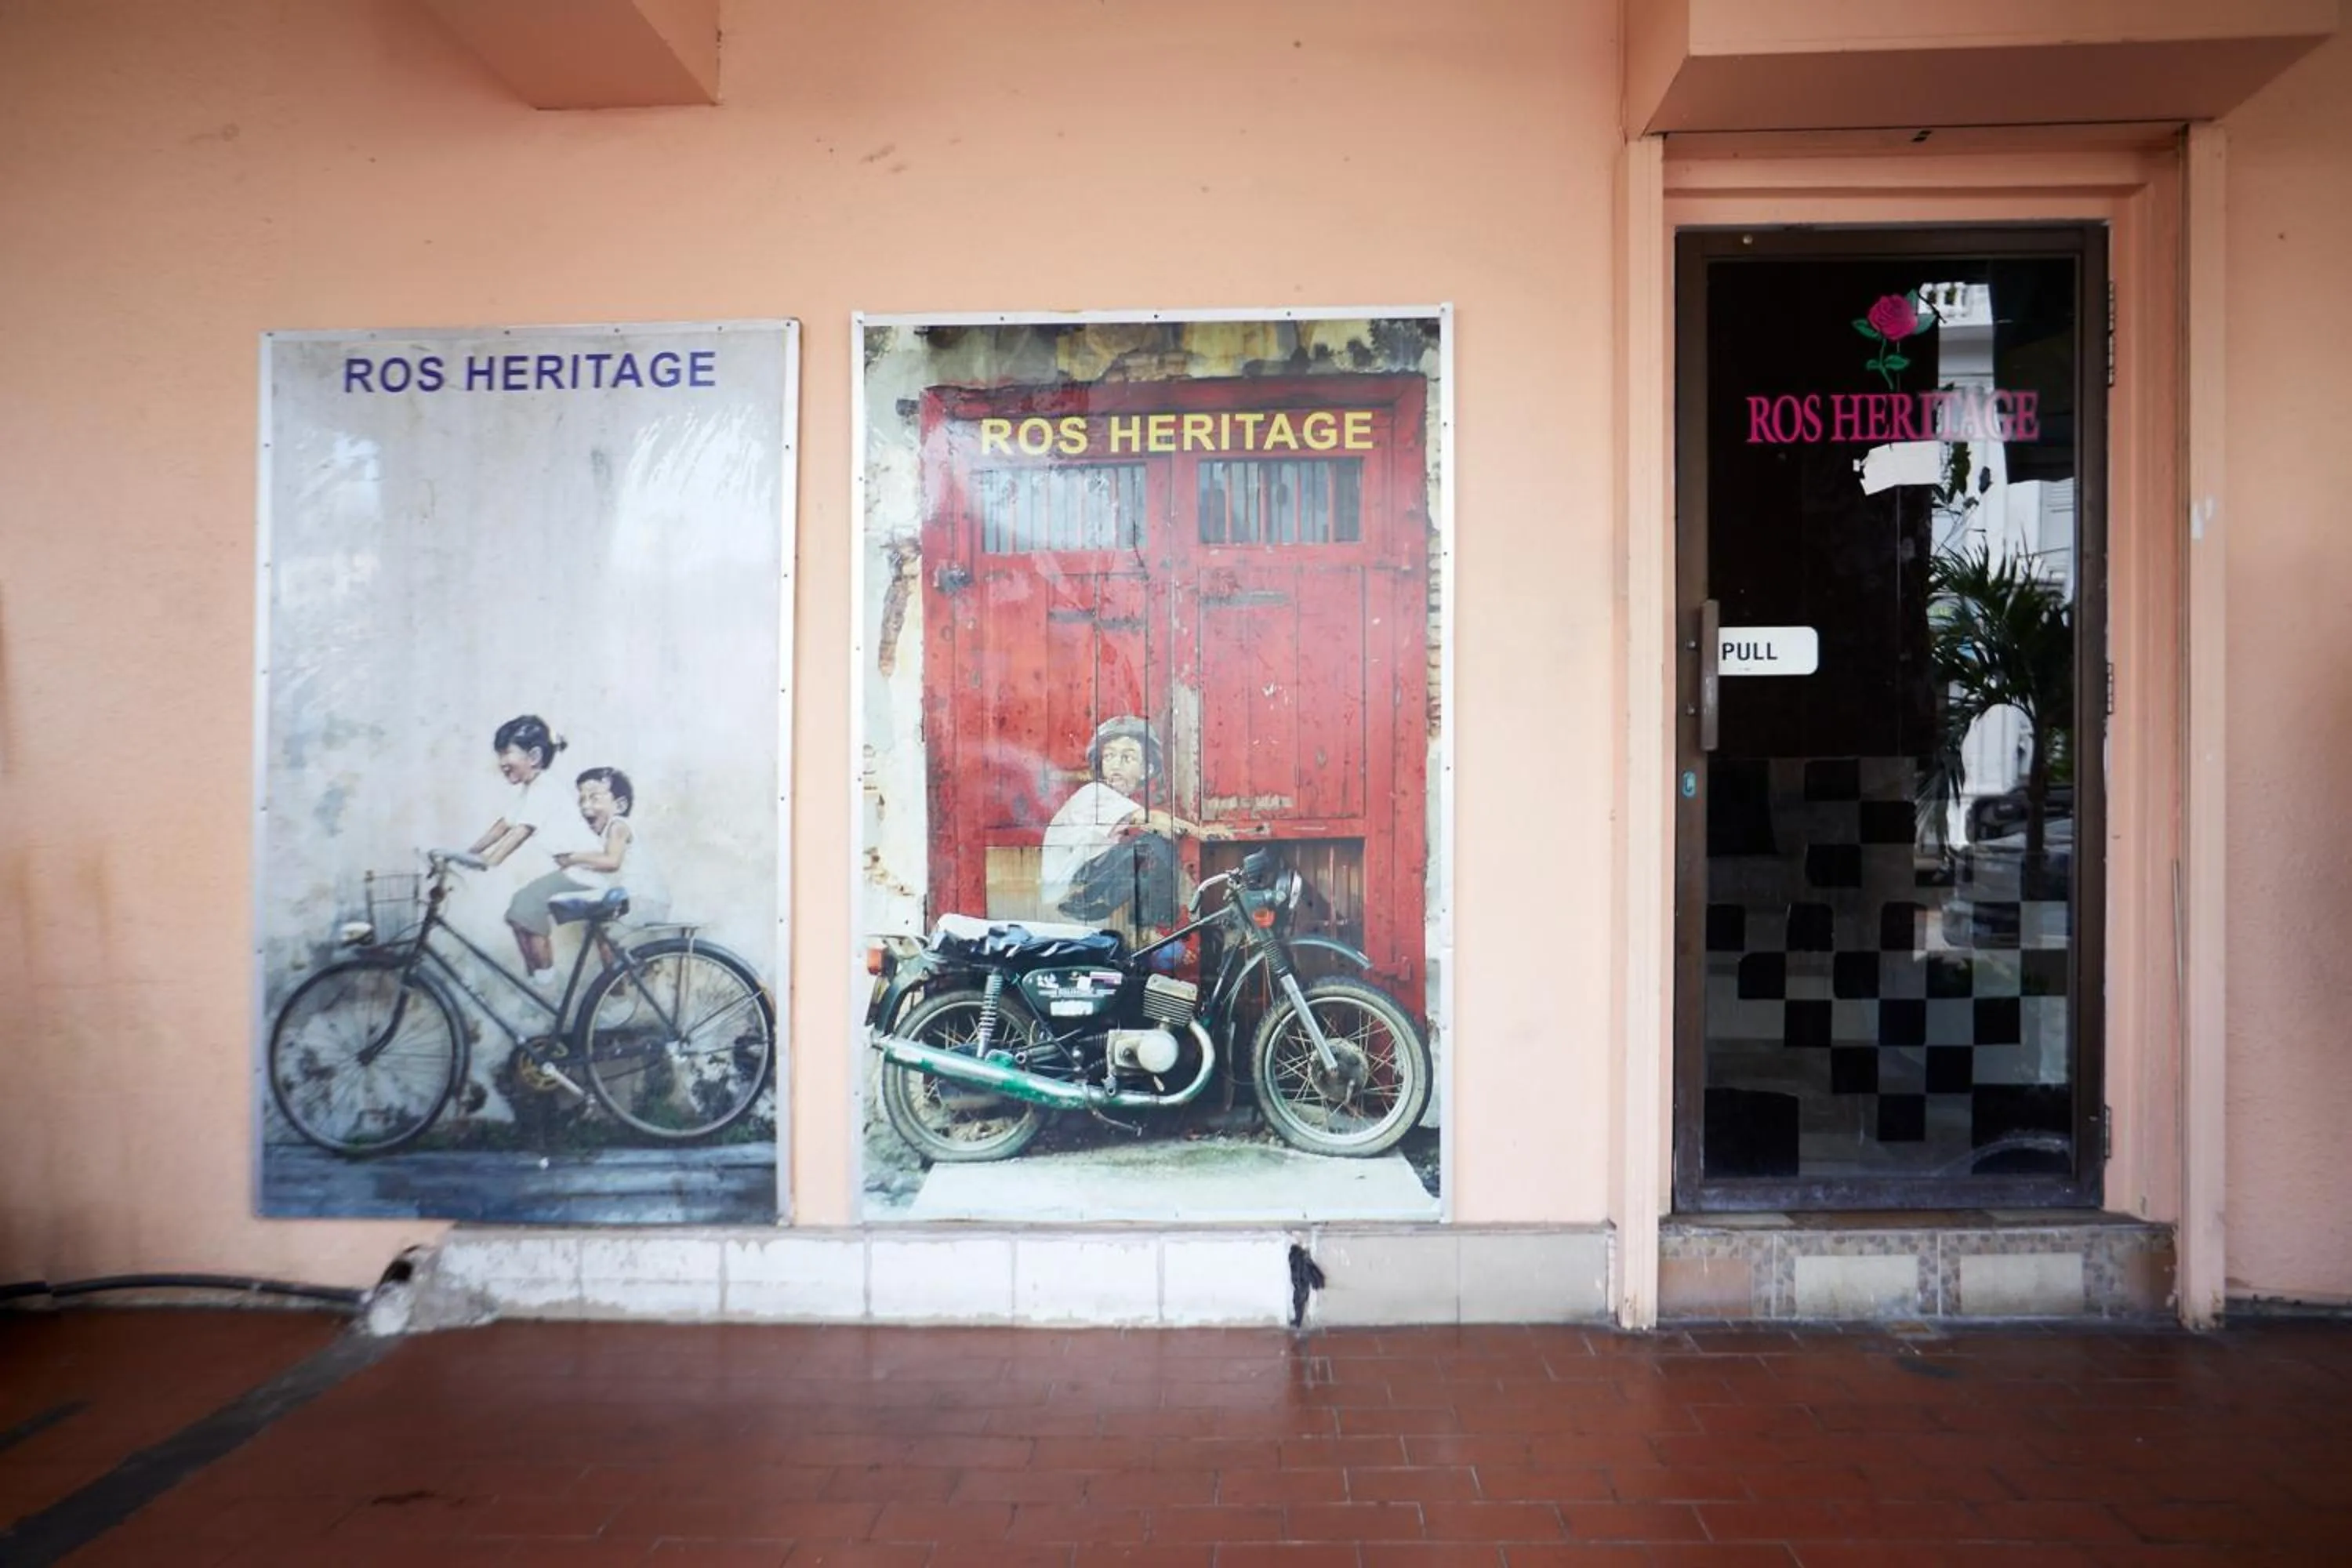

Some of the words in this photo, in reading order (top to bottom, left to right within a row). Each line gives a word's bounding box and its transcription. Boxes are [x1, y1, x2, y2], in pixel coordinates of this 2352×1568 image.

[345, 357, 445, 393] ROS
[466, 351, 717, 390] HERITAGE
[979, 416, 1088, 456] ROS
[1110, 412, 1374, 452] HERITAGE
[1746, 394, 1823, 444] ROS
[1829, 390, 2039, 441] HERITAGE
[1722, 641, 1778, 661] PULL
